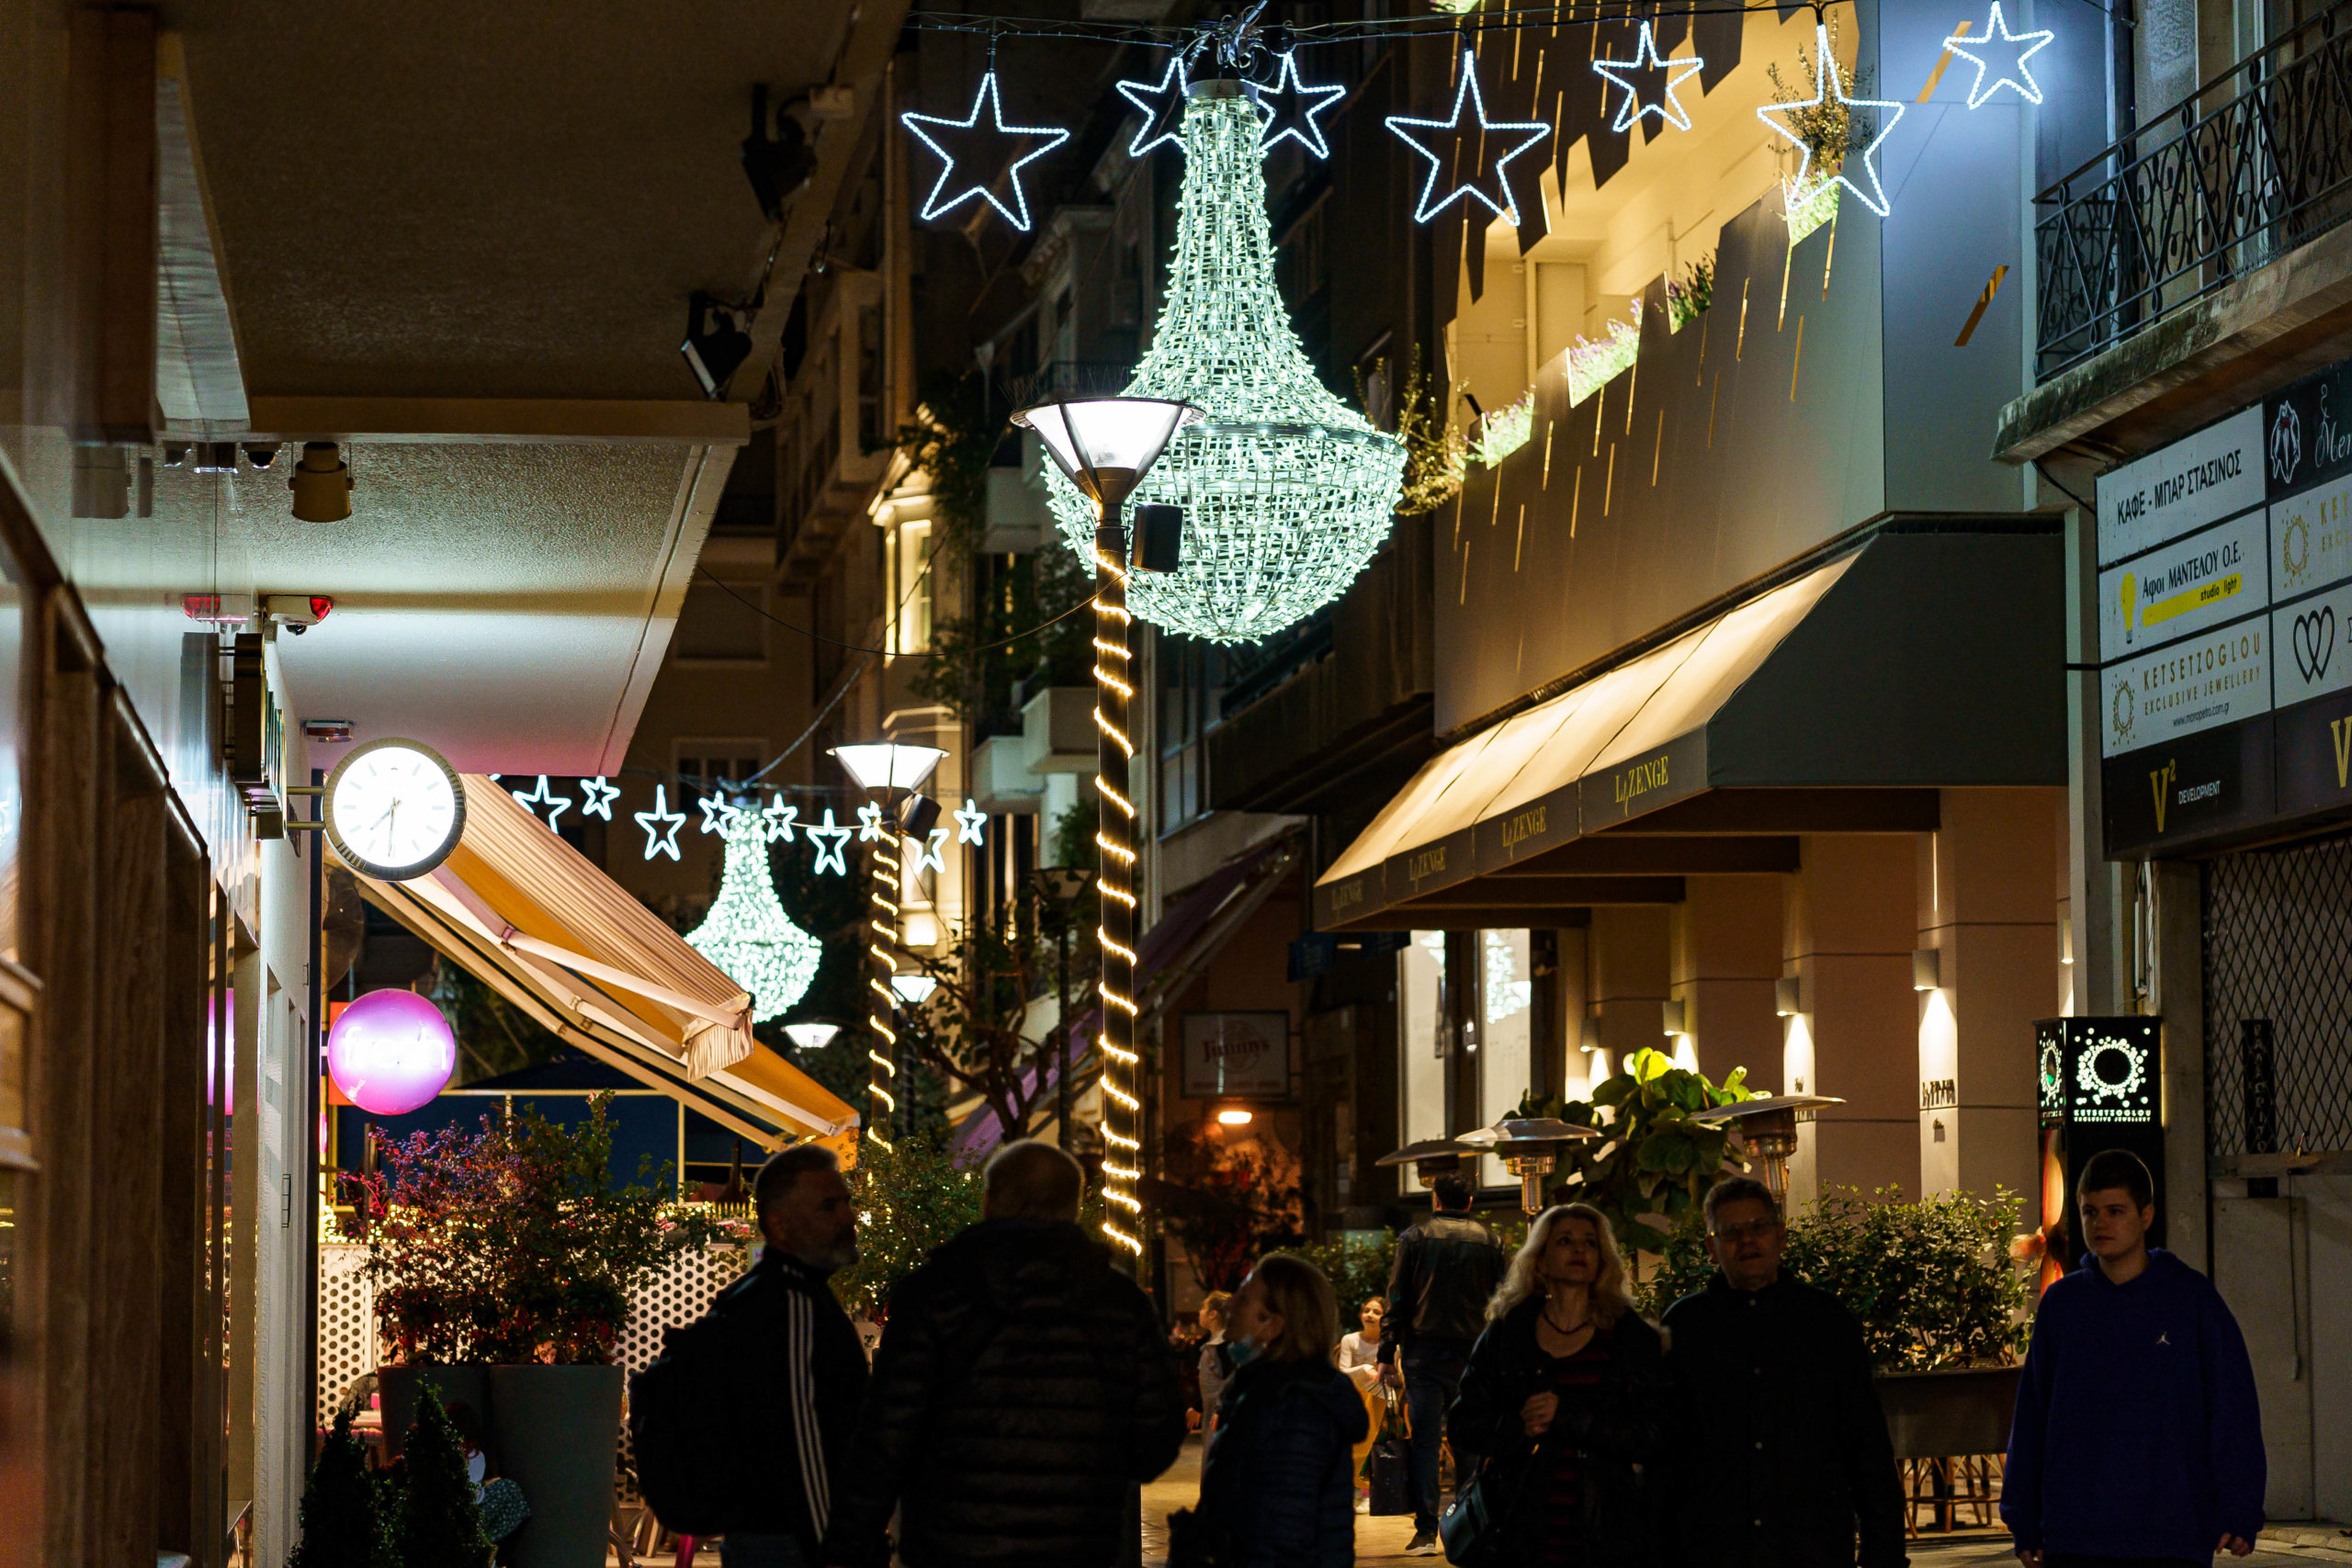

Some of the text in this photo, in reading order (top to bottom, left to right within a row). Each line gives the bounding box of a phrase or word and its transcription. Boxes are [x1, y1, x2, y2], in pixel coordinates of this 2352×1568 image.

[2117, 491, 2145, 525] ΚΑΦΕ
[2154, 473, 2185, 509] ΜΠΑΡ
[2188, 448, 2242, 495] ΣΤΑΣΙΝΟΣ
[2168, 549, 2219, 590] ΜΑΝΤΕΛΟΥ
[2222, 540, 2241, 568] Ο.Ε.
[2200, 577, 2237, 602] studio light
[2143, 632, 2260, 692] KETSETZOGLOU
[2144, 666, 2260, 716] EXCLUSIVE JEWELLERY
[2178, 780, 2221, 805] DEVELOPMENT
